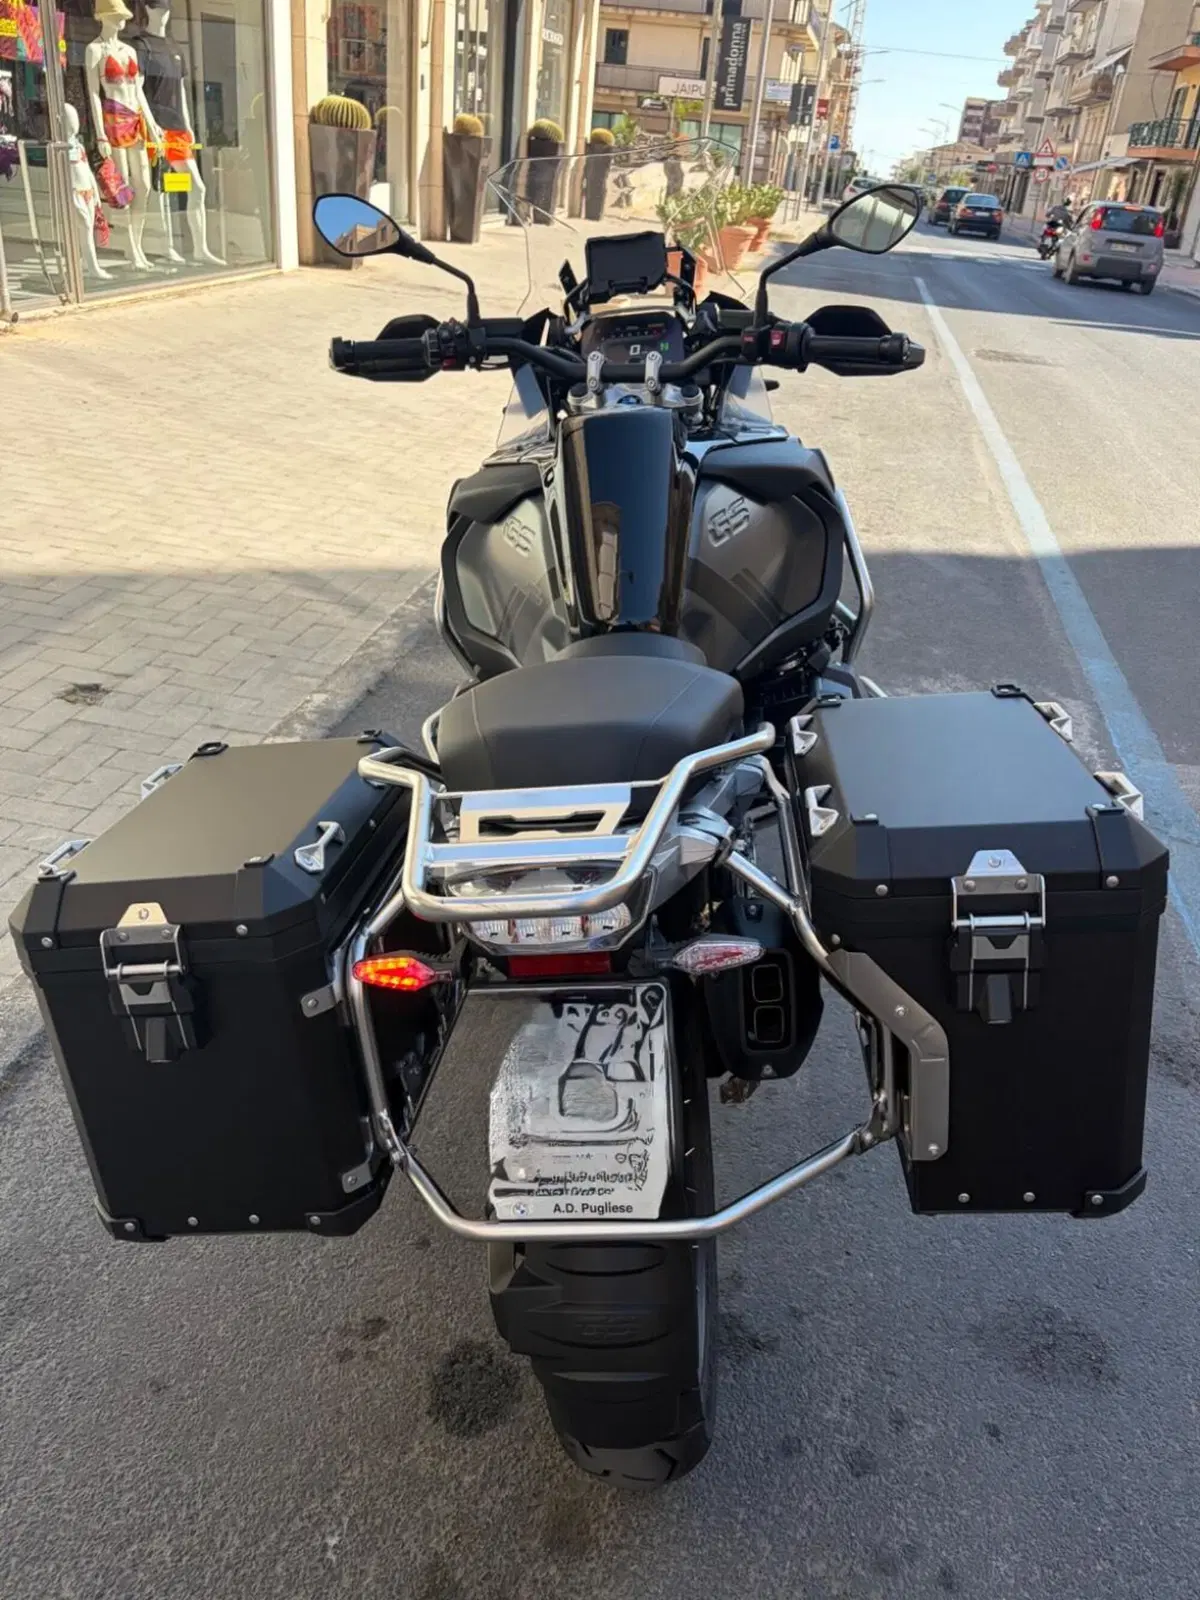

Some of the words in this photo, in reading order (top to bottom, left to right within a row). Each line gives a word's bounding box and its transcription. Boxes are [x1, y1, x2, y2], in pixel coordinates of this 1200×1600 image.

[722, 23, 742, 107] primadonna
[502, 515, 536, 557] GS
[707, 497, 750, 547] GS
[553, 1203, 578, 1213] A.D.
[582, 1202, 633, 1215] Pugliese
